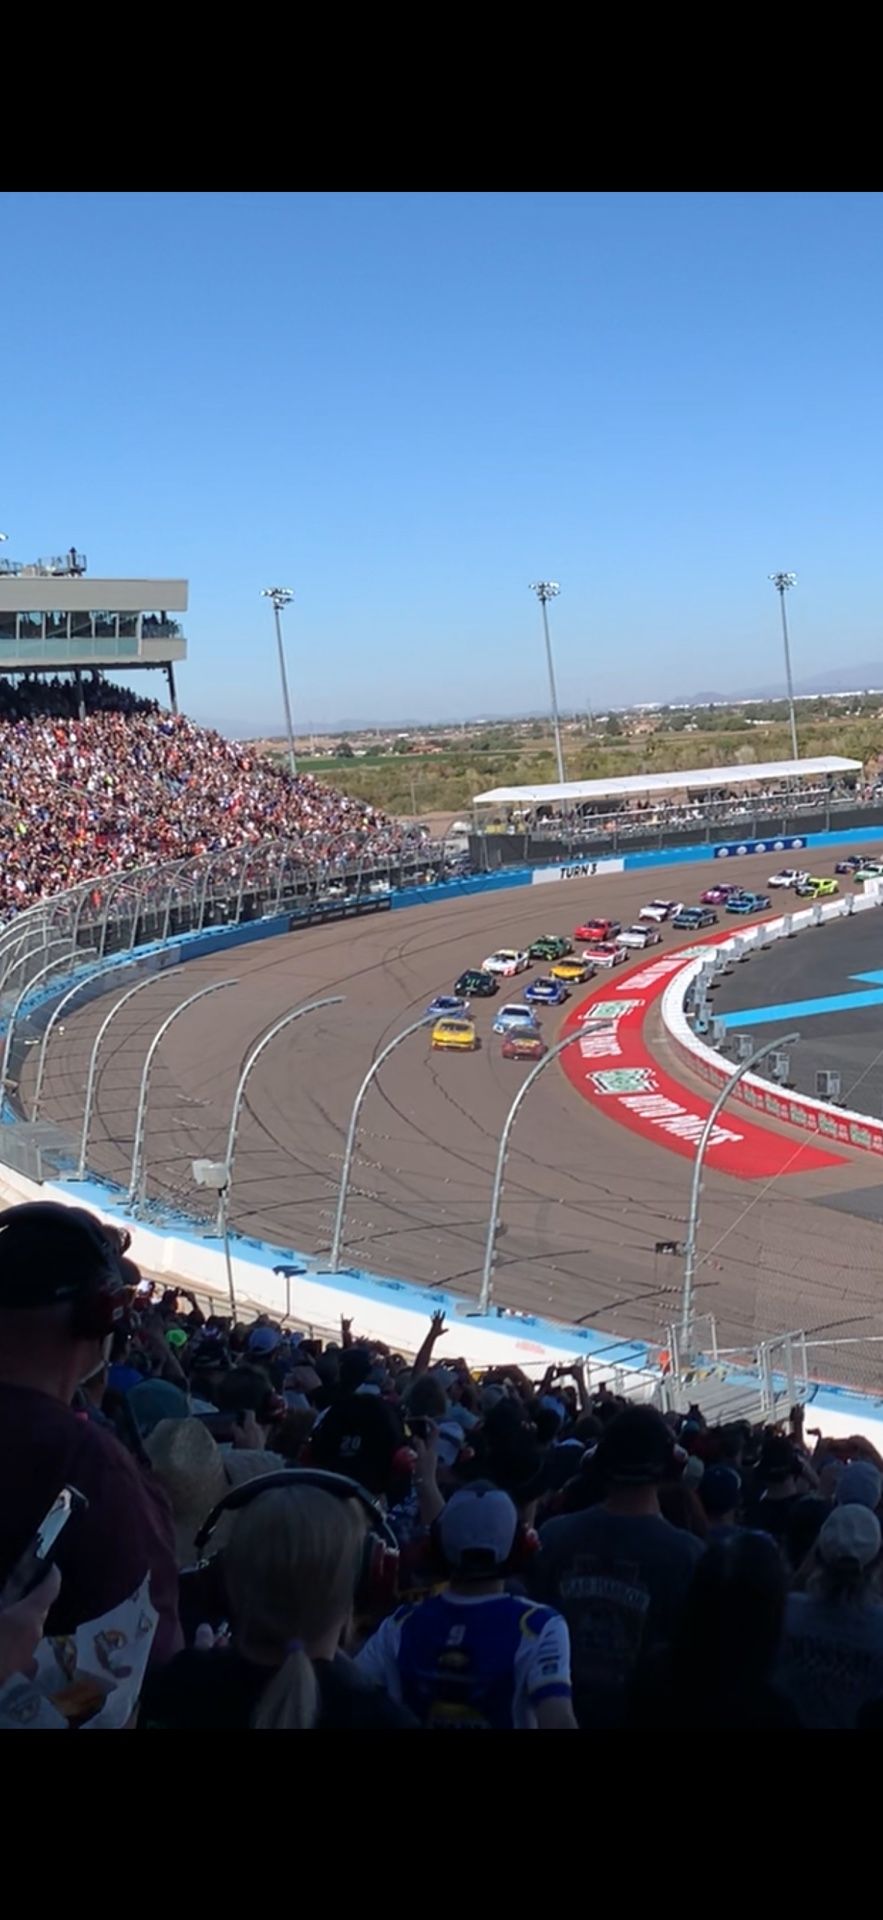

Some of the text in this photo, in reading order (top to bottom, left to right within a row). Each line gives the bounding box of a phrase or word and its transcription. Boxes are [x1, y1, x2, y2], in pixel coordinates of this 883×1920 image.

[560, 862, 598, 880] TURN 3
[449, 1624, 466, 1643] 9
